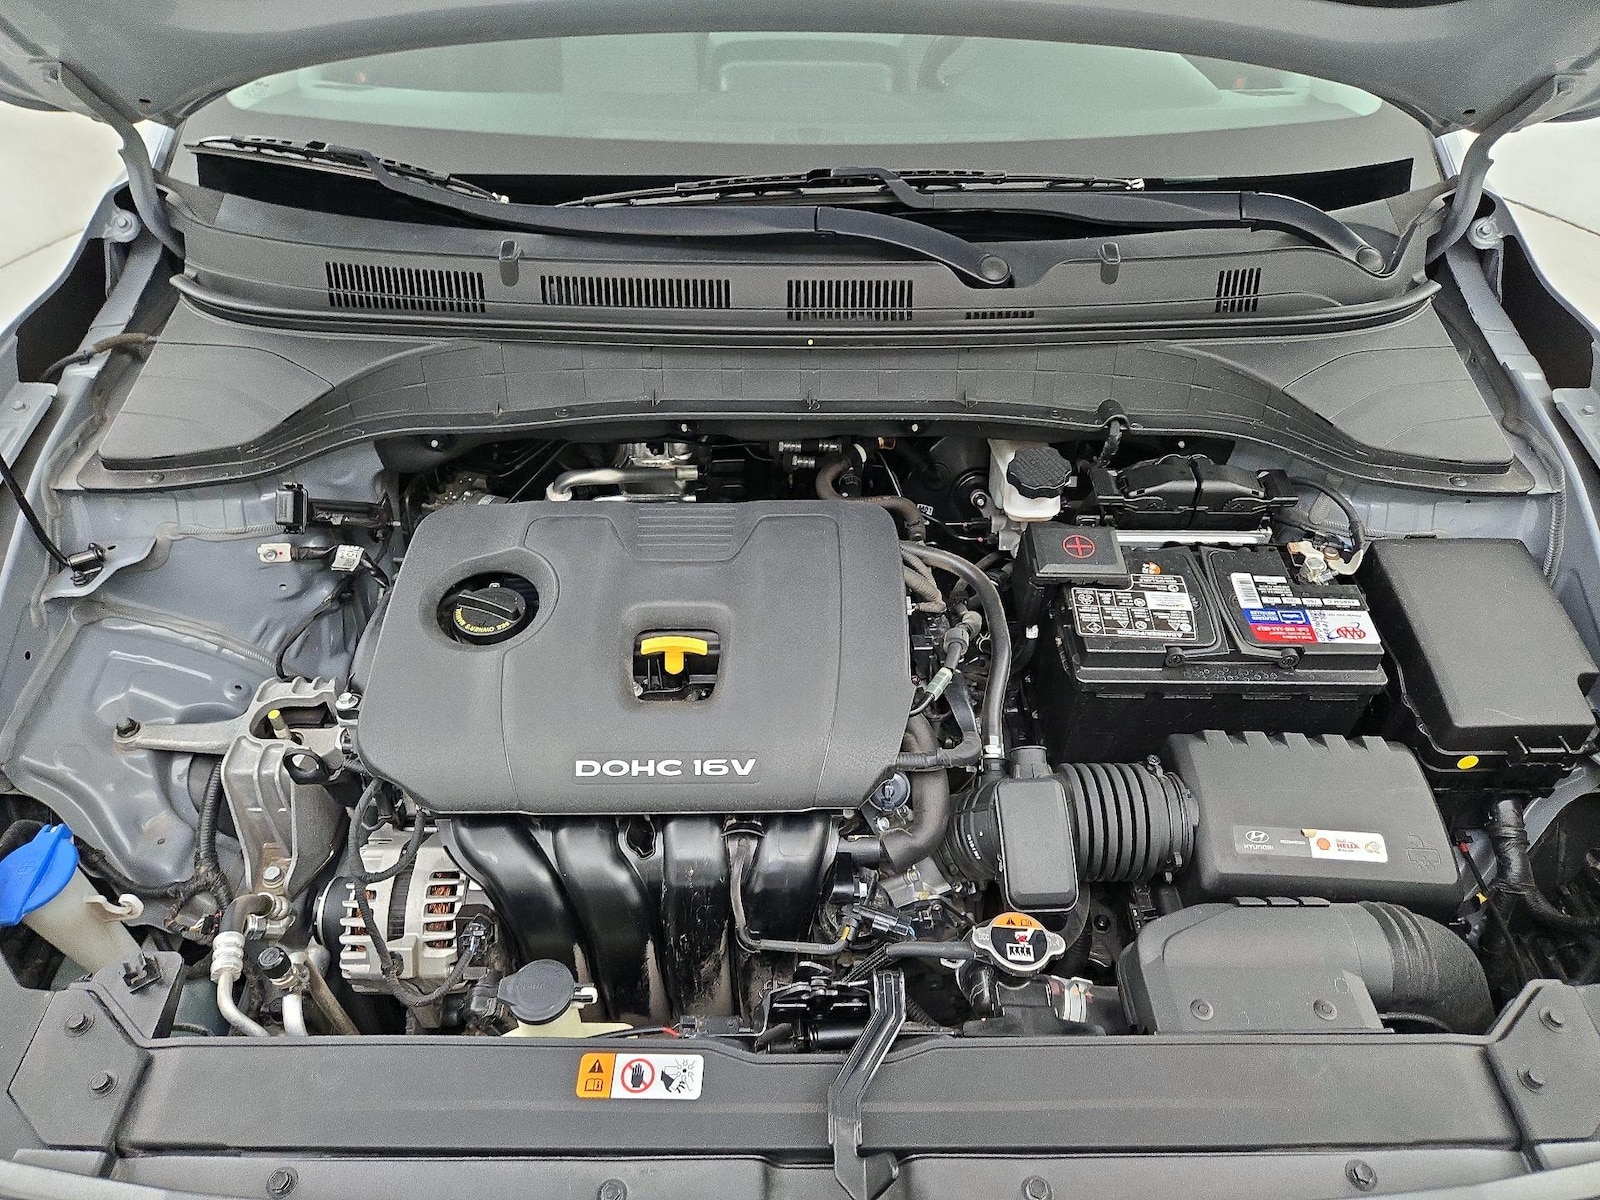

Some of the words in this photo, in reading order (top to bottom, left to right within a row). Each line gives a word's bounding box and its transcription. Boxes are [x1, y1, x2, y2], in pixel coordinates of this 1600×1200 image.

[575, 759, 683, 777] DOHC
[693, 757, 757, 776] 16V
[1243, 843, 1275, 851] HYUNDAI
